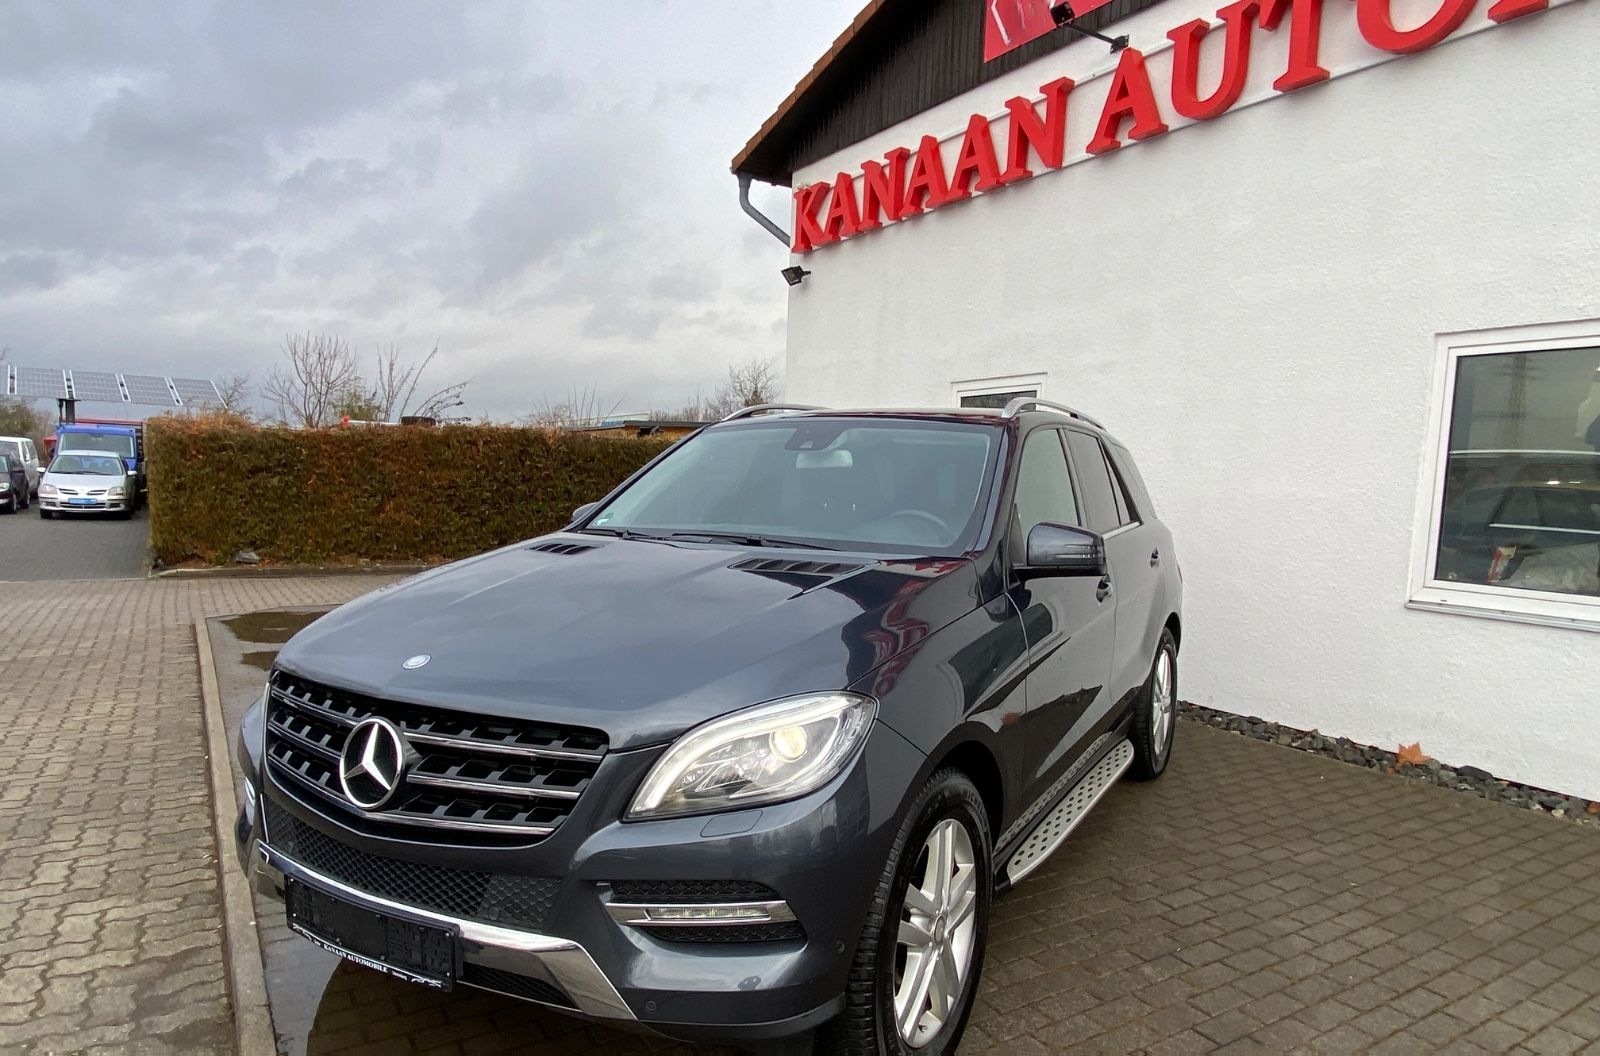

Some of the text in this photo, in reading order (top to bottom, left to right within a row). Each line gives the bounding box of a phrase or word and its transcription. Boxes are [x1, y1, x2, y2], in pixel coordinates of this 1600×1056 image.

[791, 0, 1549, 254] KANAAN AUTO
[347, 954, 388, 973] AUTOMOBILE
